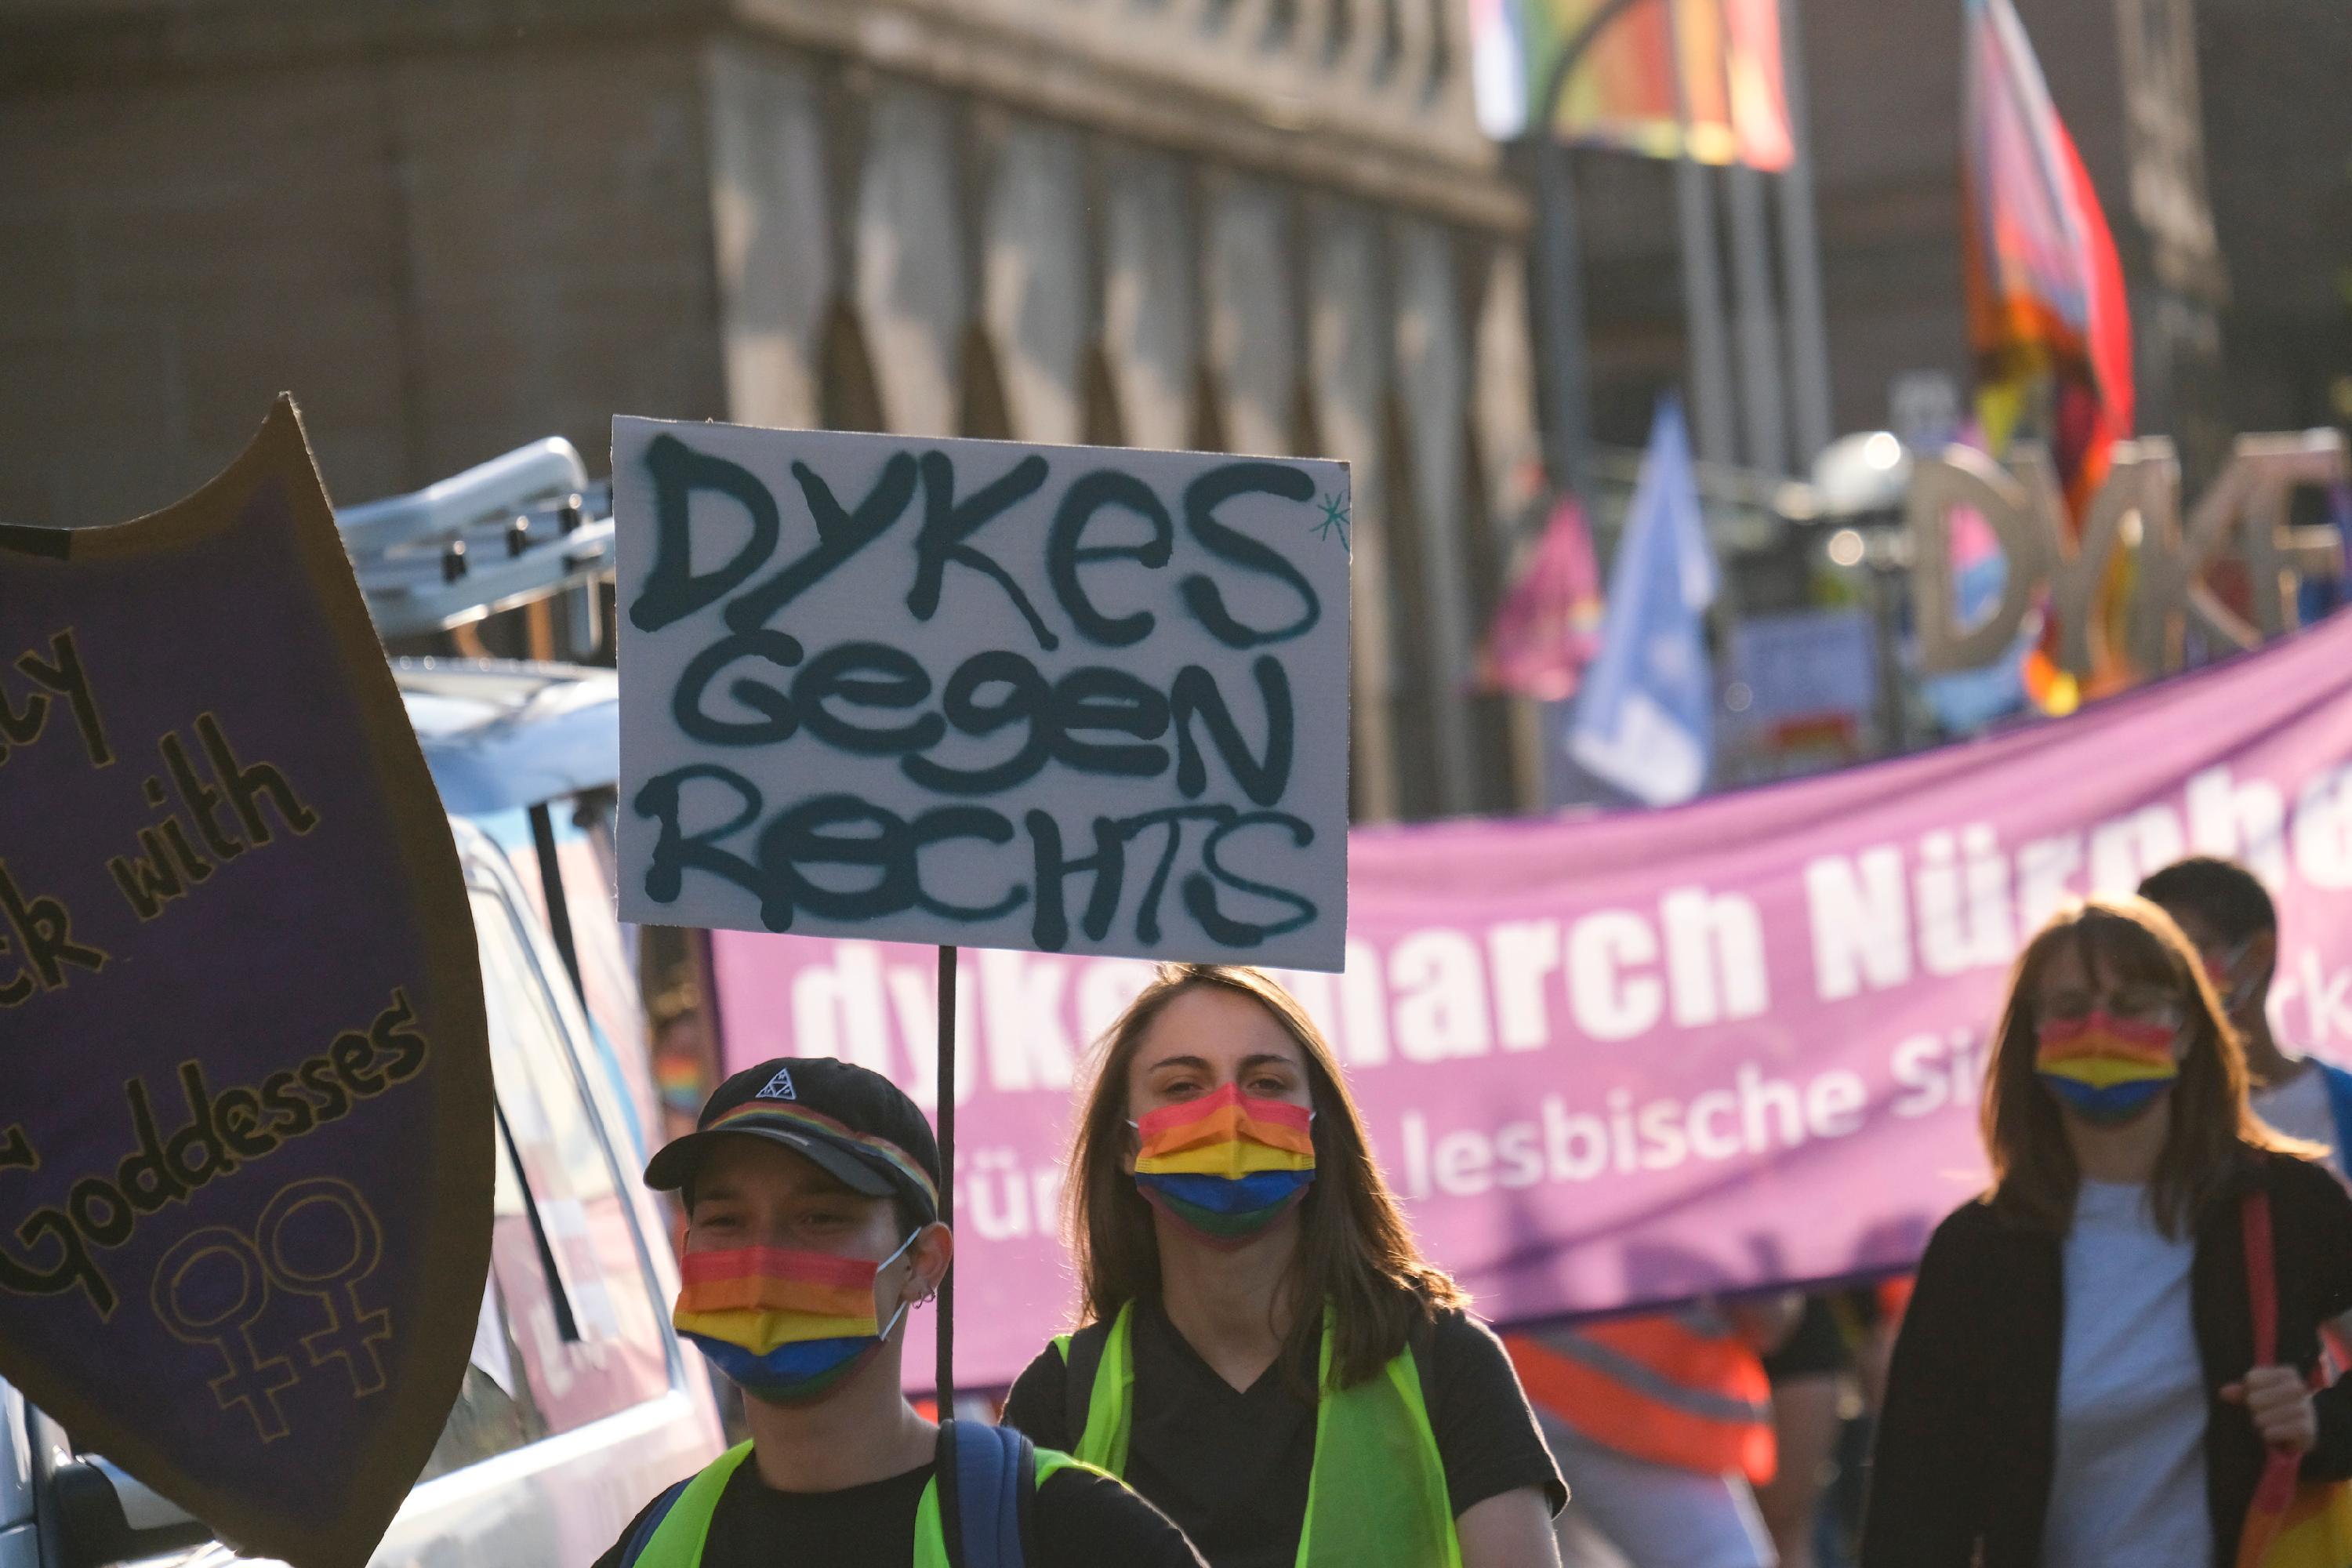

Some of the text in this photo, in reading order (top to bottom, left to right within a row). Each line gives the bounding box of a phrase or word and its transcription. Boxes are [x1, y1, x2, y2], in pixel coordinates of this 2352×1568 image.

[107, 711, 320, 922] with
[0, 986, 429, 1323] Goddesses
[1401, 1062, 1868, 1200] lesbische
